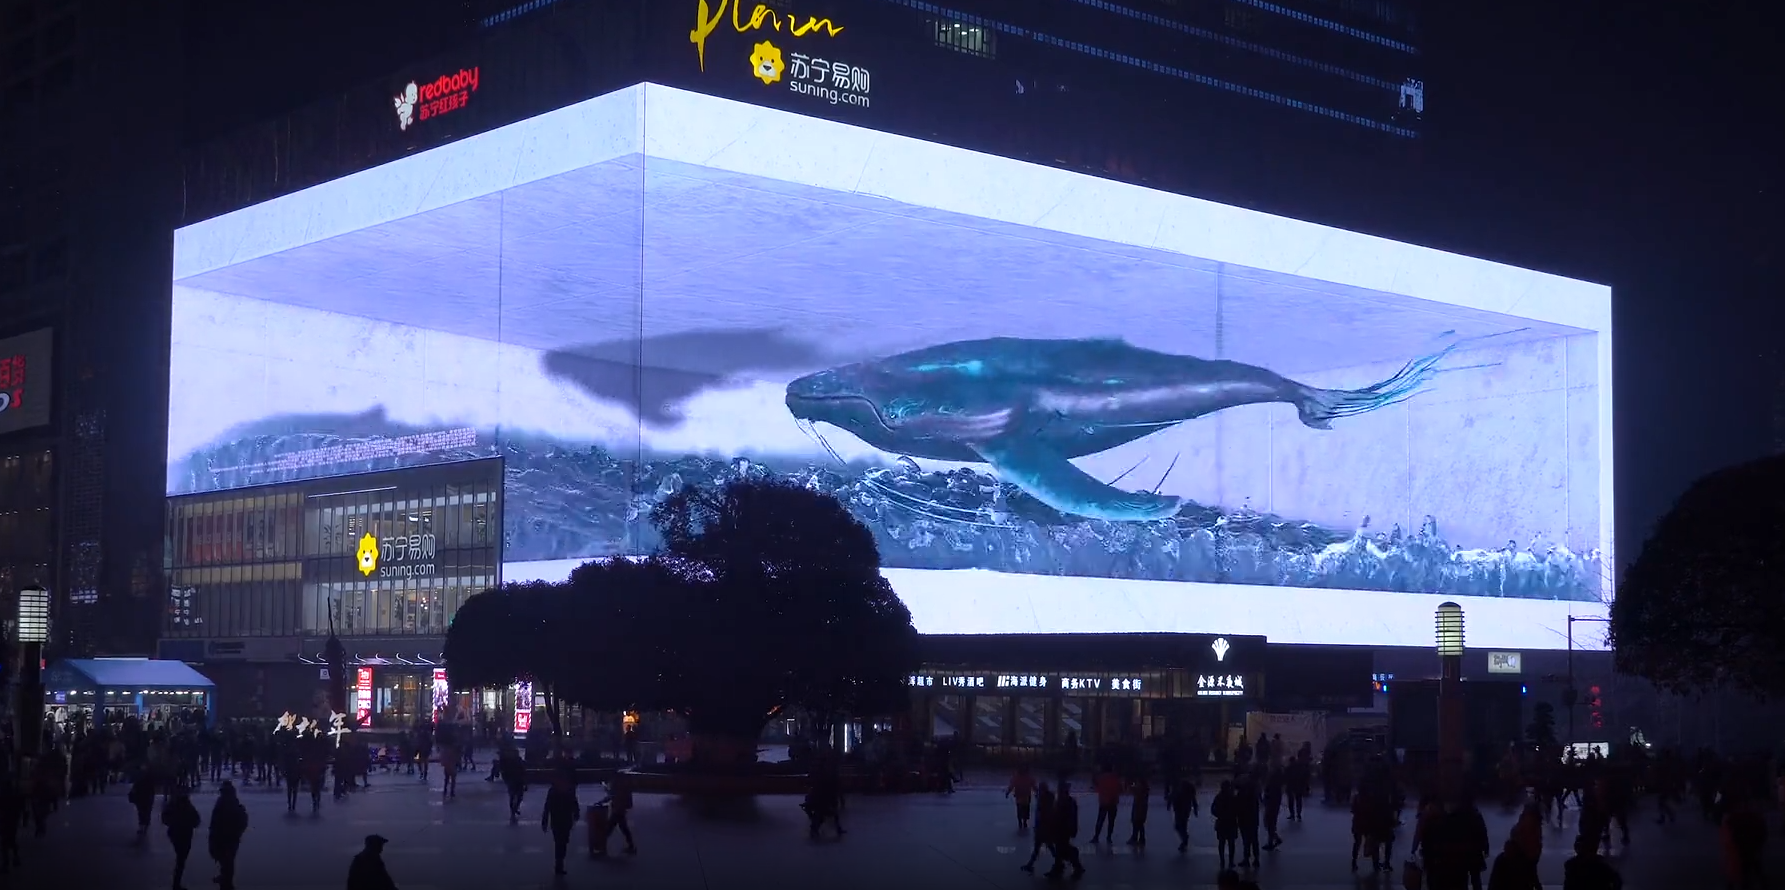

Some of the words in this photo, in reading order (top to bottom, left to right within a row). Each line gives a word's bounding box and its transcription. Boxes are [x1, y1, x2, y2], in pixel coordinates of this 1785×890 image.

[419, 66, 479, 103] redbaby
[790, 52, 870, 93] 苏宁易购
[420, 90, 468, 120] 苏宁红孩子
[790, 80, 870, 107] suning.com
[381, 533, 436, 561] 苏宁易购
[380, 563, 435, 580] suning.com
[1010, 675, 1047, 687] 海派健身
[1061, 677, 1101, 690] 商务KTV
[1111, 677, 1142, 690] 美食街
